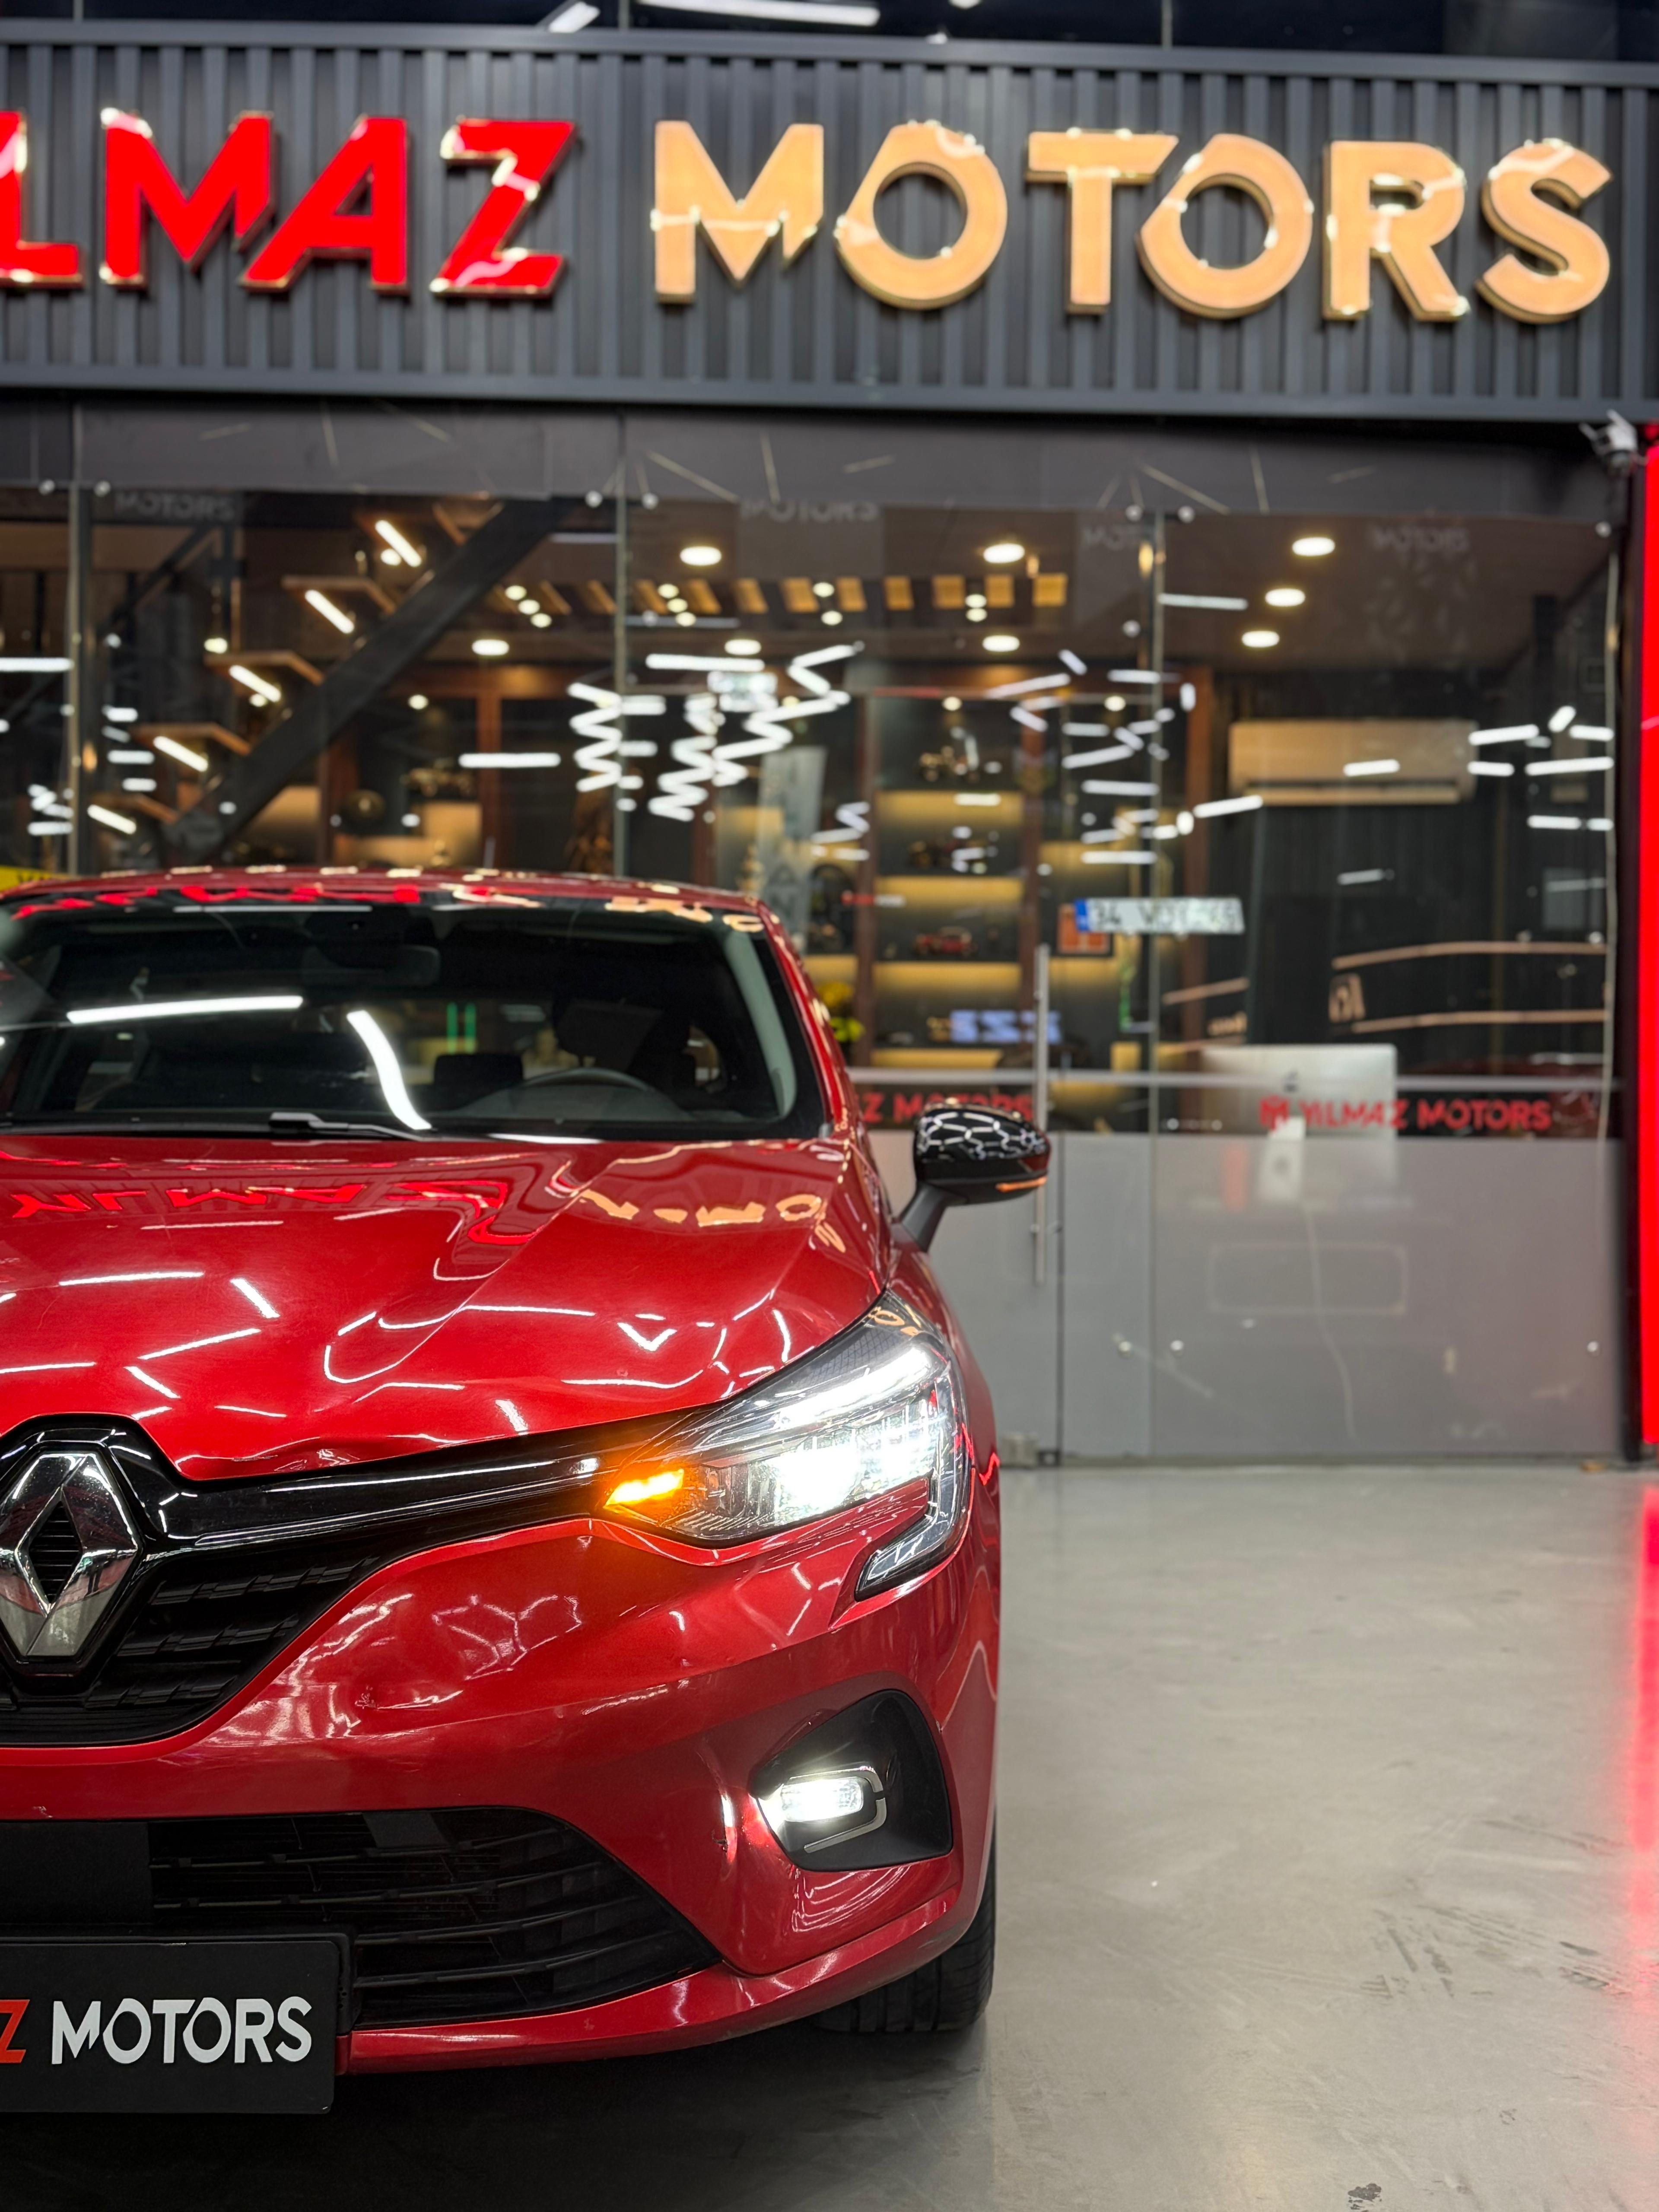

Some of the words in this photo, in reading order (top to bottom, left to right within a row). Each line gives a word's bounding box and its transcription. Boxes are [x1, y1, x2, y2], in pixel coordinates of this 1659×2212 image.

[652, 120, 1612, 323] MOTORS
[1297, 1099, 1409, 1128] YILMAZ
[1416, 1099, 1552, 1129] MOTORS
[51, 1996, 312, 2064] MOTORS
